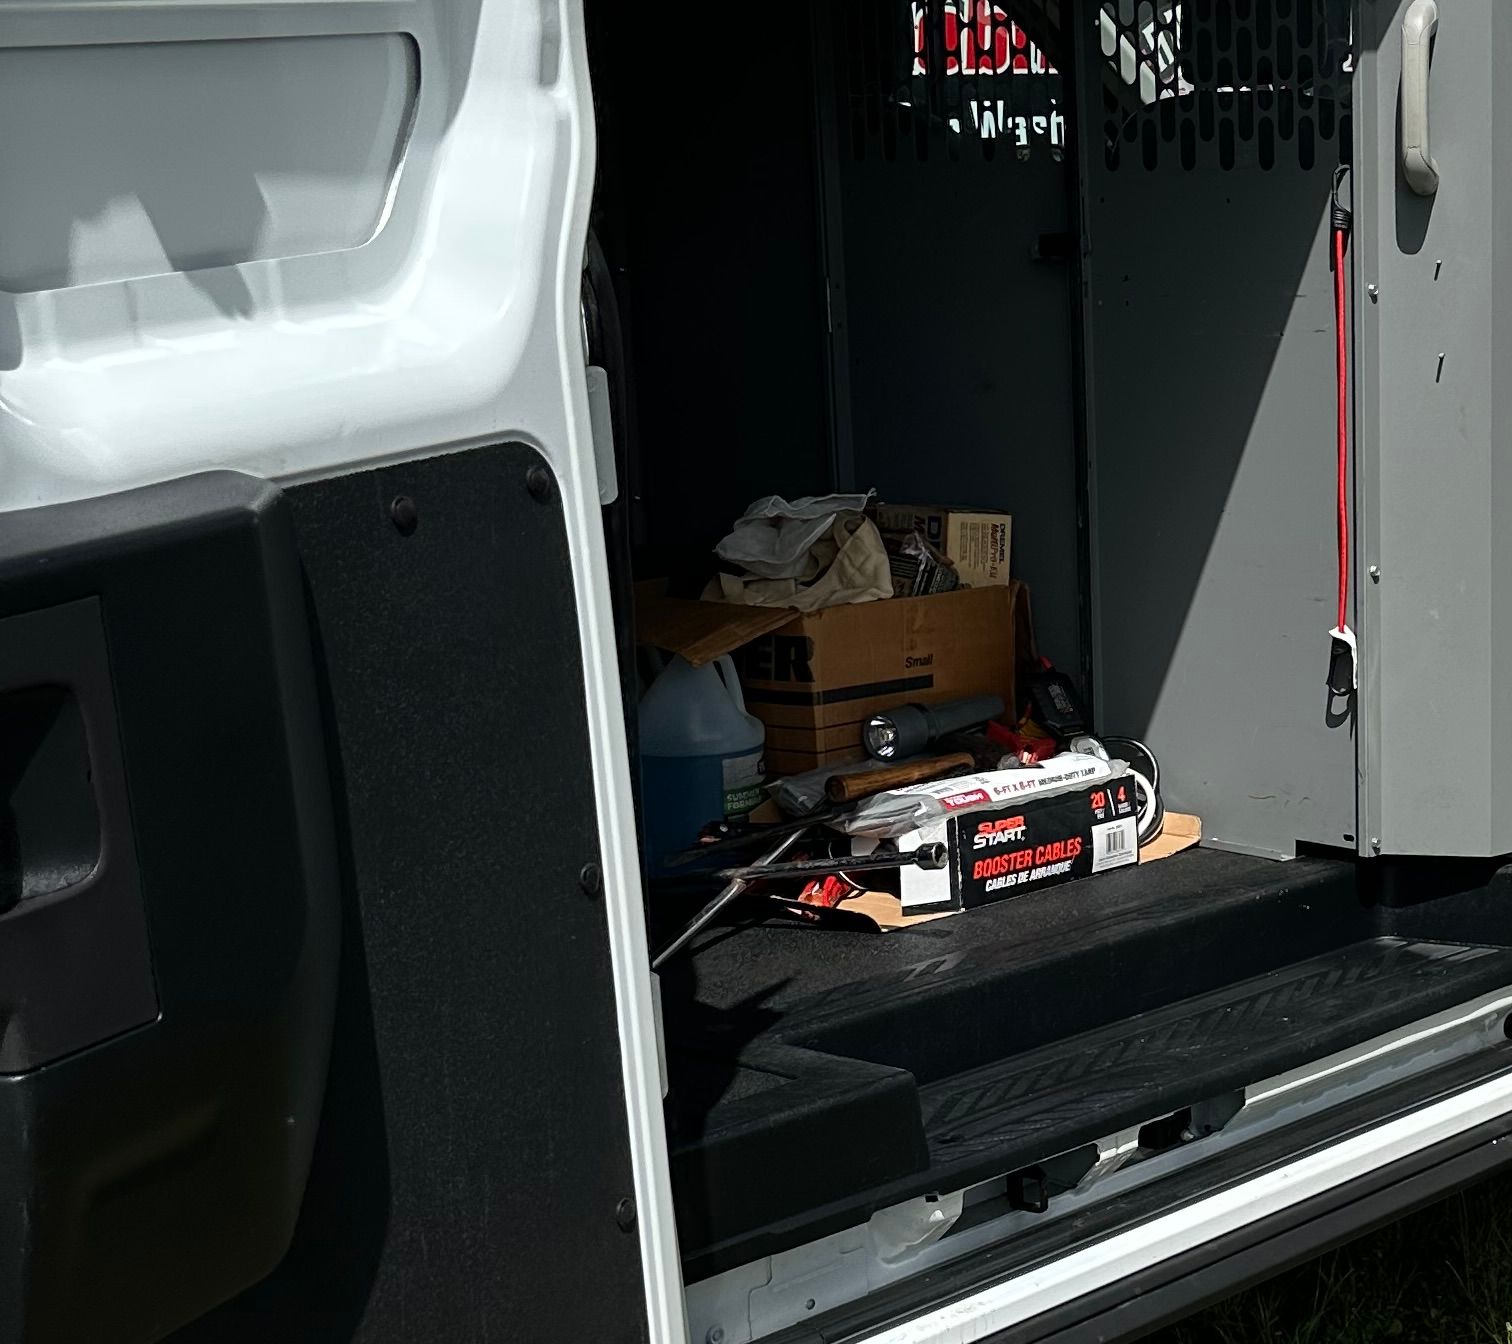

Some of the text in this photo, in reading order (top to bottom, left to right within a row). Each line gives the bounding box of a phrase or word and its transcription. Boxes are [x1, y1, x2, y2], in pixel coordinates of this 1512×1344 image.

[905, 653, 934, 669] Small
[1090, 791, 1105, 809] 20
[1117, 786, 1126, 802] 4
[977, 815, 1025, 833] SUPER
[972, 825, 1027, 850] START
[973, 848, 1033, 880] BOOSTER
[1035, 837, 1082, 865] CABLES
[1017, 870, 1030, 885] DE
[1029, 860, 1072, 882] ARRANQUE
